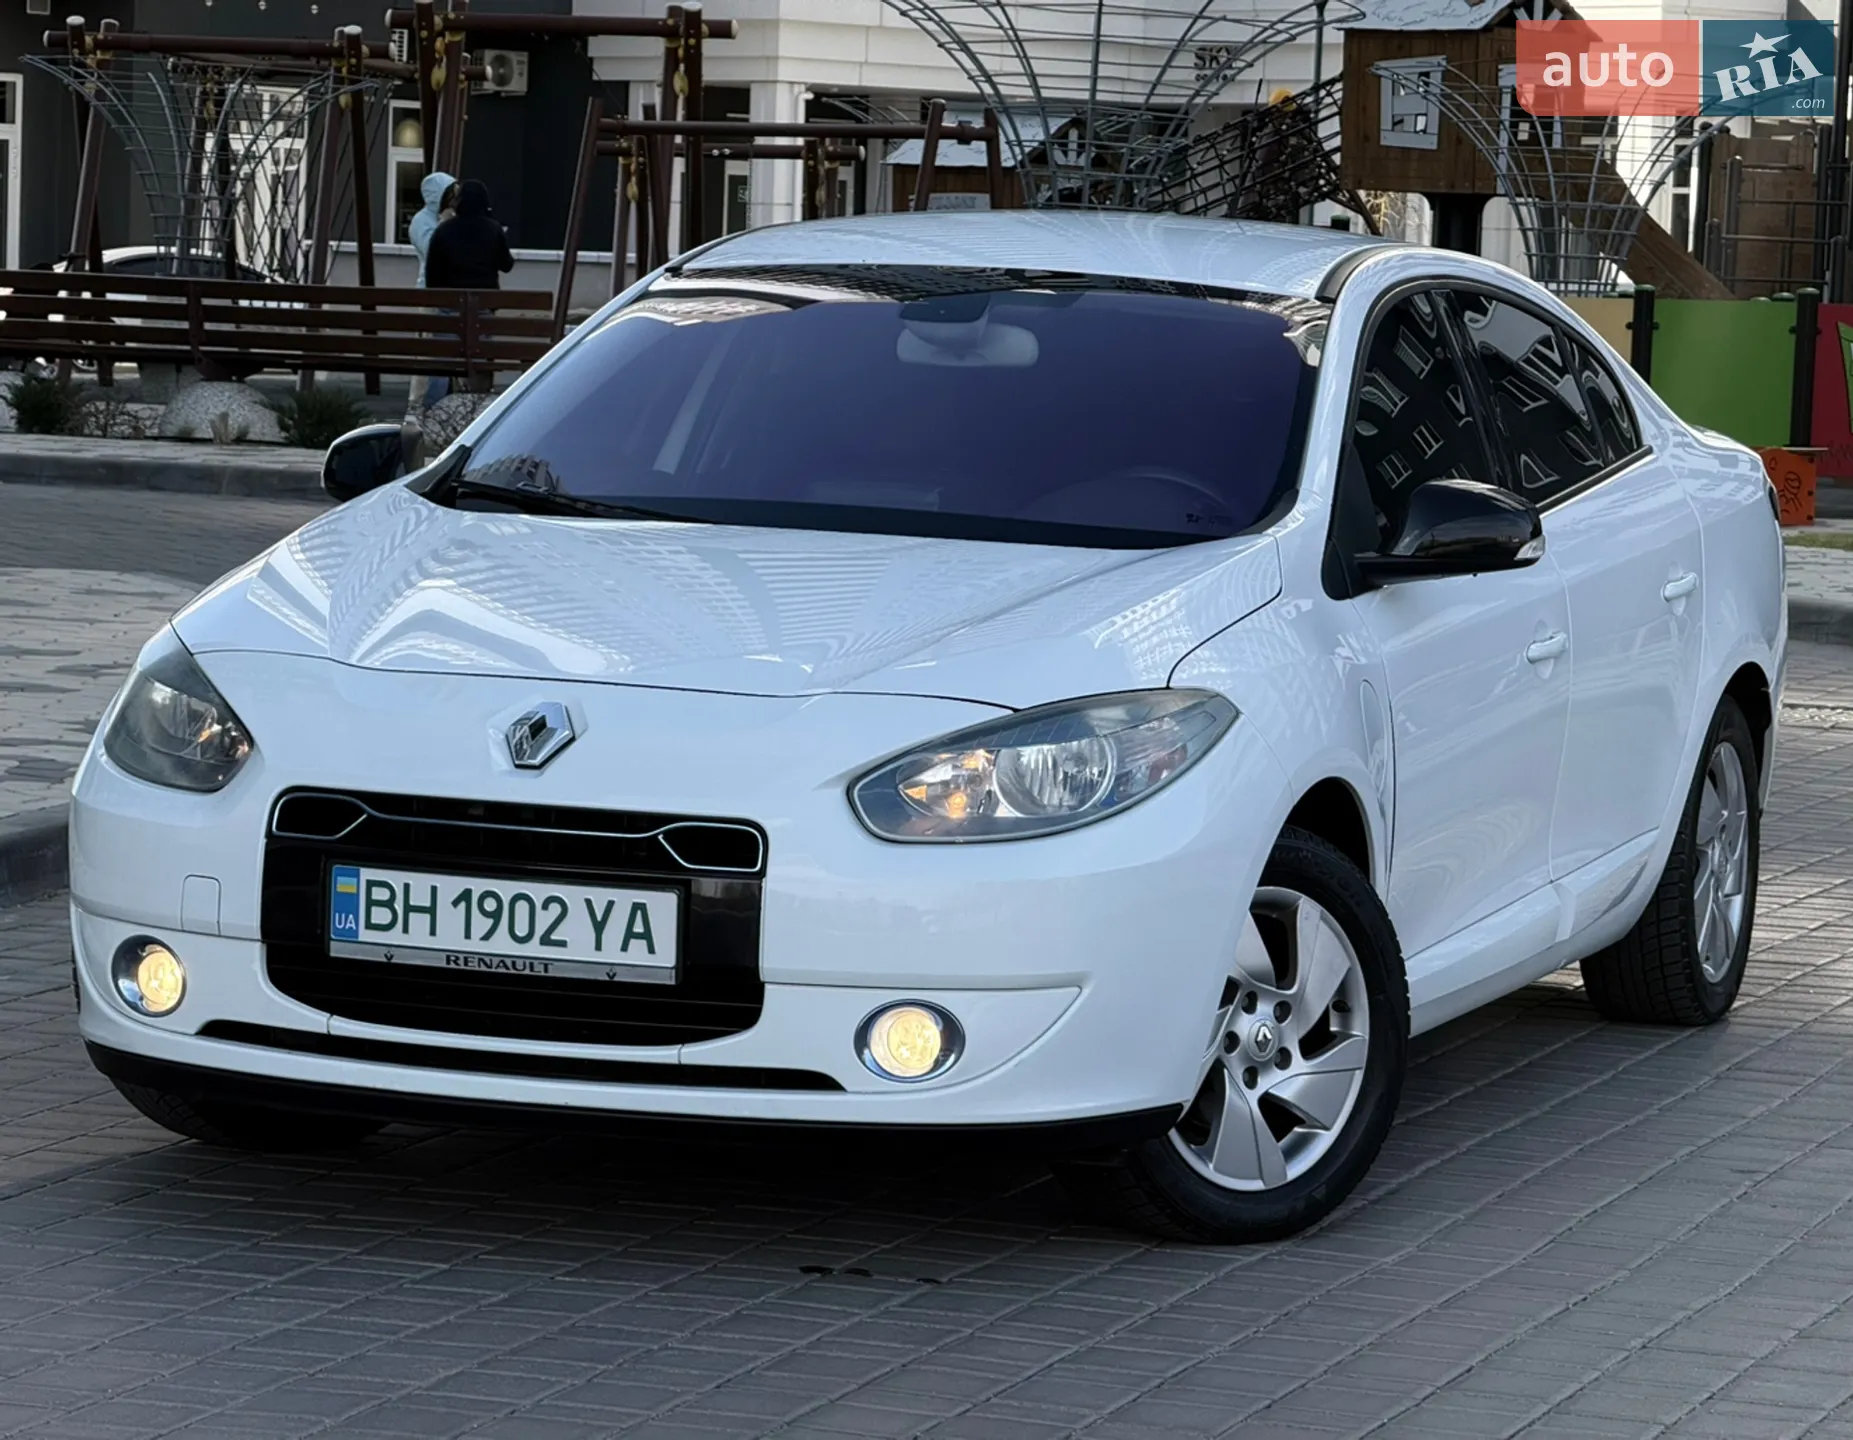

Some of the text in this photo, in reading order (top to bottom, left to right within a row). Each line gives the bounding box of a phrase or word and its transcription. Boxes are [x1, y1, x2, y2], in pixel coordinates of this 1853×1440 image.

[335, 912, 356, 930] UA
[364, 879, 656, 955] BH 1902 YA
[445, 954, 554, 974] RENAULT
